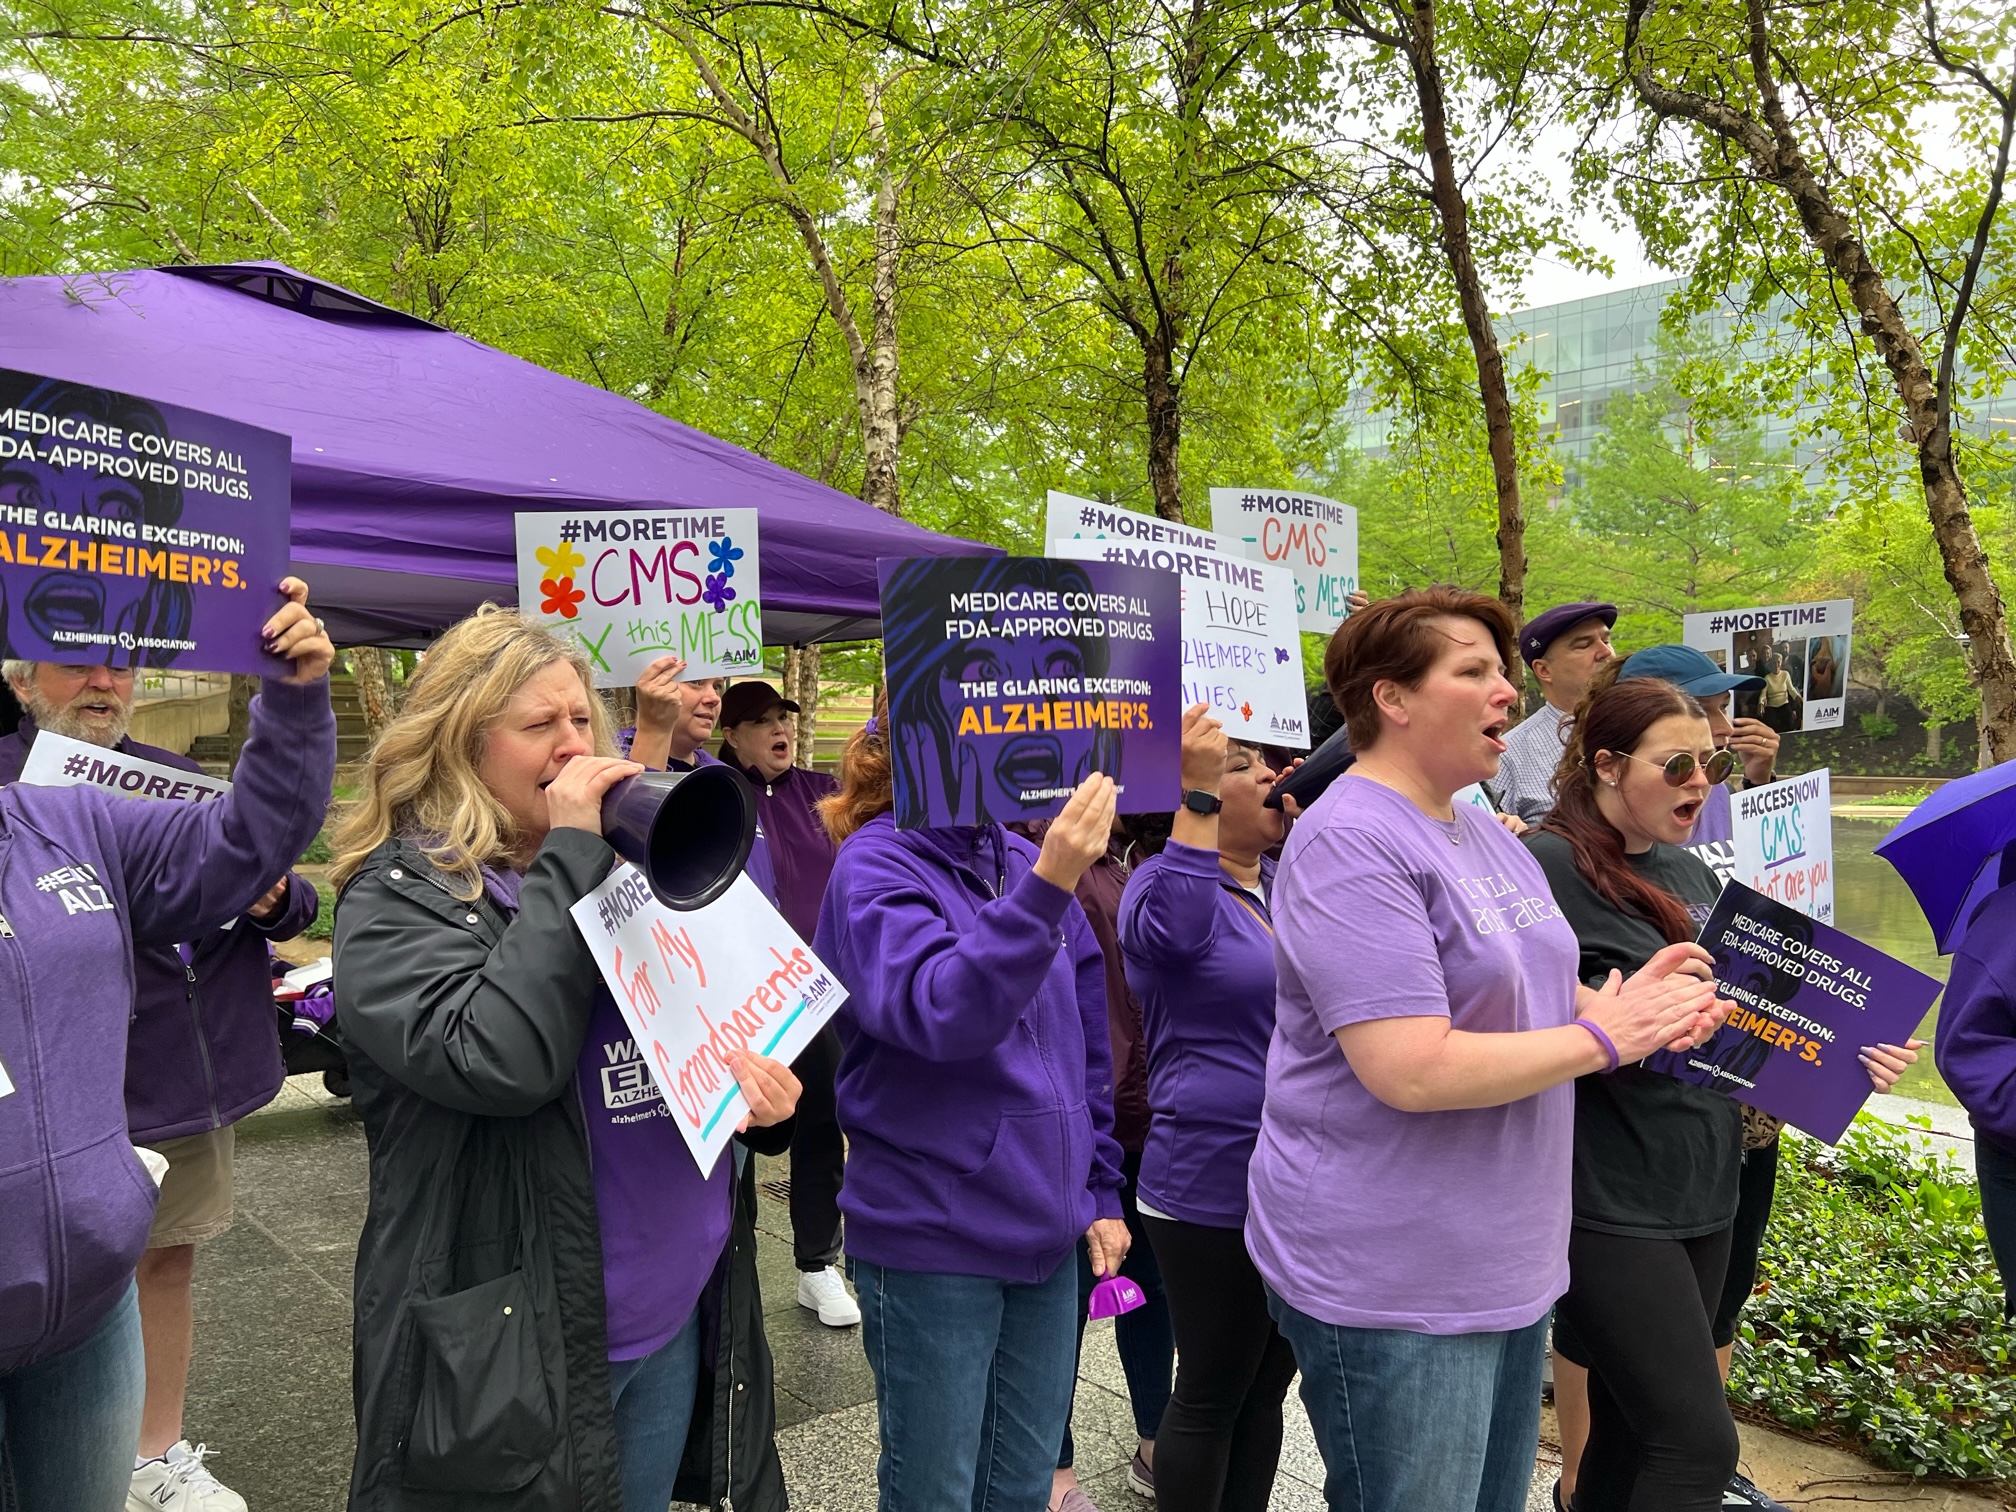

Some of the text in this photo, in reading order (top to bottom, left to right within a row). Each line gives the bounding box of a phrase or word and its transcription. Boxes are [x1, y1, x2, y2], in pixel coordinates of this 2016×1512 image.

[0, 408, 247, 475] MEDICARE COVERS ALL
[0, 435, 252, 501] DA-APPROVED DRUGS.
[1241, 494, 1343, 525] #MORETIME
[44, 511, 137, 539] GLARING
[142, 525, 245, 555] EXCEPTION:
[560, 516, 726, 543] #MORETIME
[0, 531, 248, 590] ALZHEIMER'S.
[592, 541, 702, 607] CMS
[1102, 546, 1265, 593] #MORETIME
[950, 592, 1151, 617] MEDICARE COVERS ALL
[1205, 590, 1269, 627] HOPE
[1709, 607, 1827, 634] #MORETIME
[52, 630, 196, 651] ALZHEIMER'S ASSOCIATION
[626, 618, 673, 645] this
[681, 599, 763, 666] MESS
[945, 618, 1155, 642] FDA-APPROVED DRUGS.
[734, 648, 756, 662] AIM
[1181, 638, 1267, 675] ZHEIMER'S
[960, 678, 1152, 698] THE GLARING EXCEPTION:
[958, 701, 1153, 736] ALZHEIMER'S.
[1281, 717, 1303, 733] AIM
[1823, 706, 1840, 718] AIM
[1741, 777, 1820, 821] #ACCESSNOW
[1784, 870, 1805, 902] are
[1807, 860, 1829, 904] you
[597, 869, 653, 937] #MORE
[1732, 912, 1872, 991] MEDICARE COVERS ALL
[614, 918, 707, 1030] For My
[809, 973, 832, 1001] AIM
[1721, 930, 1867, 1011] FDA-APPROVED DRUGS.
[1719, 981, 1836, 1043] GLARING EXCEPTION:
[1726, 1006, 1823, 1067] EIMER'S.
[610, 1085, 660, 1106] ALZHE
[611, 1108, 657, 1124] alzheimer's
